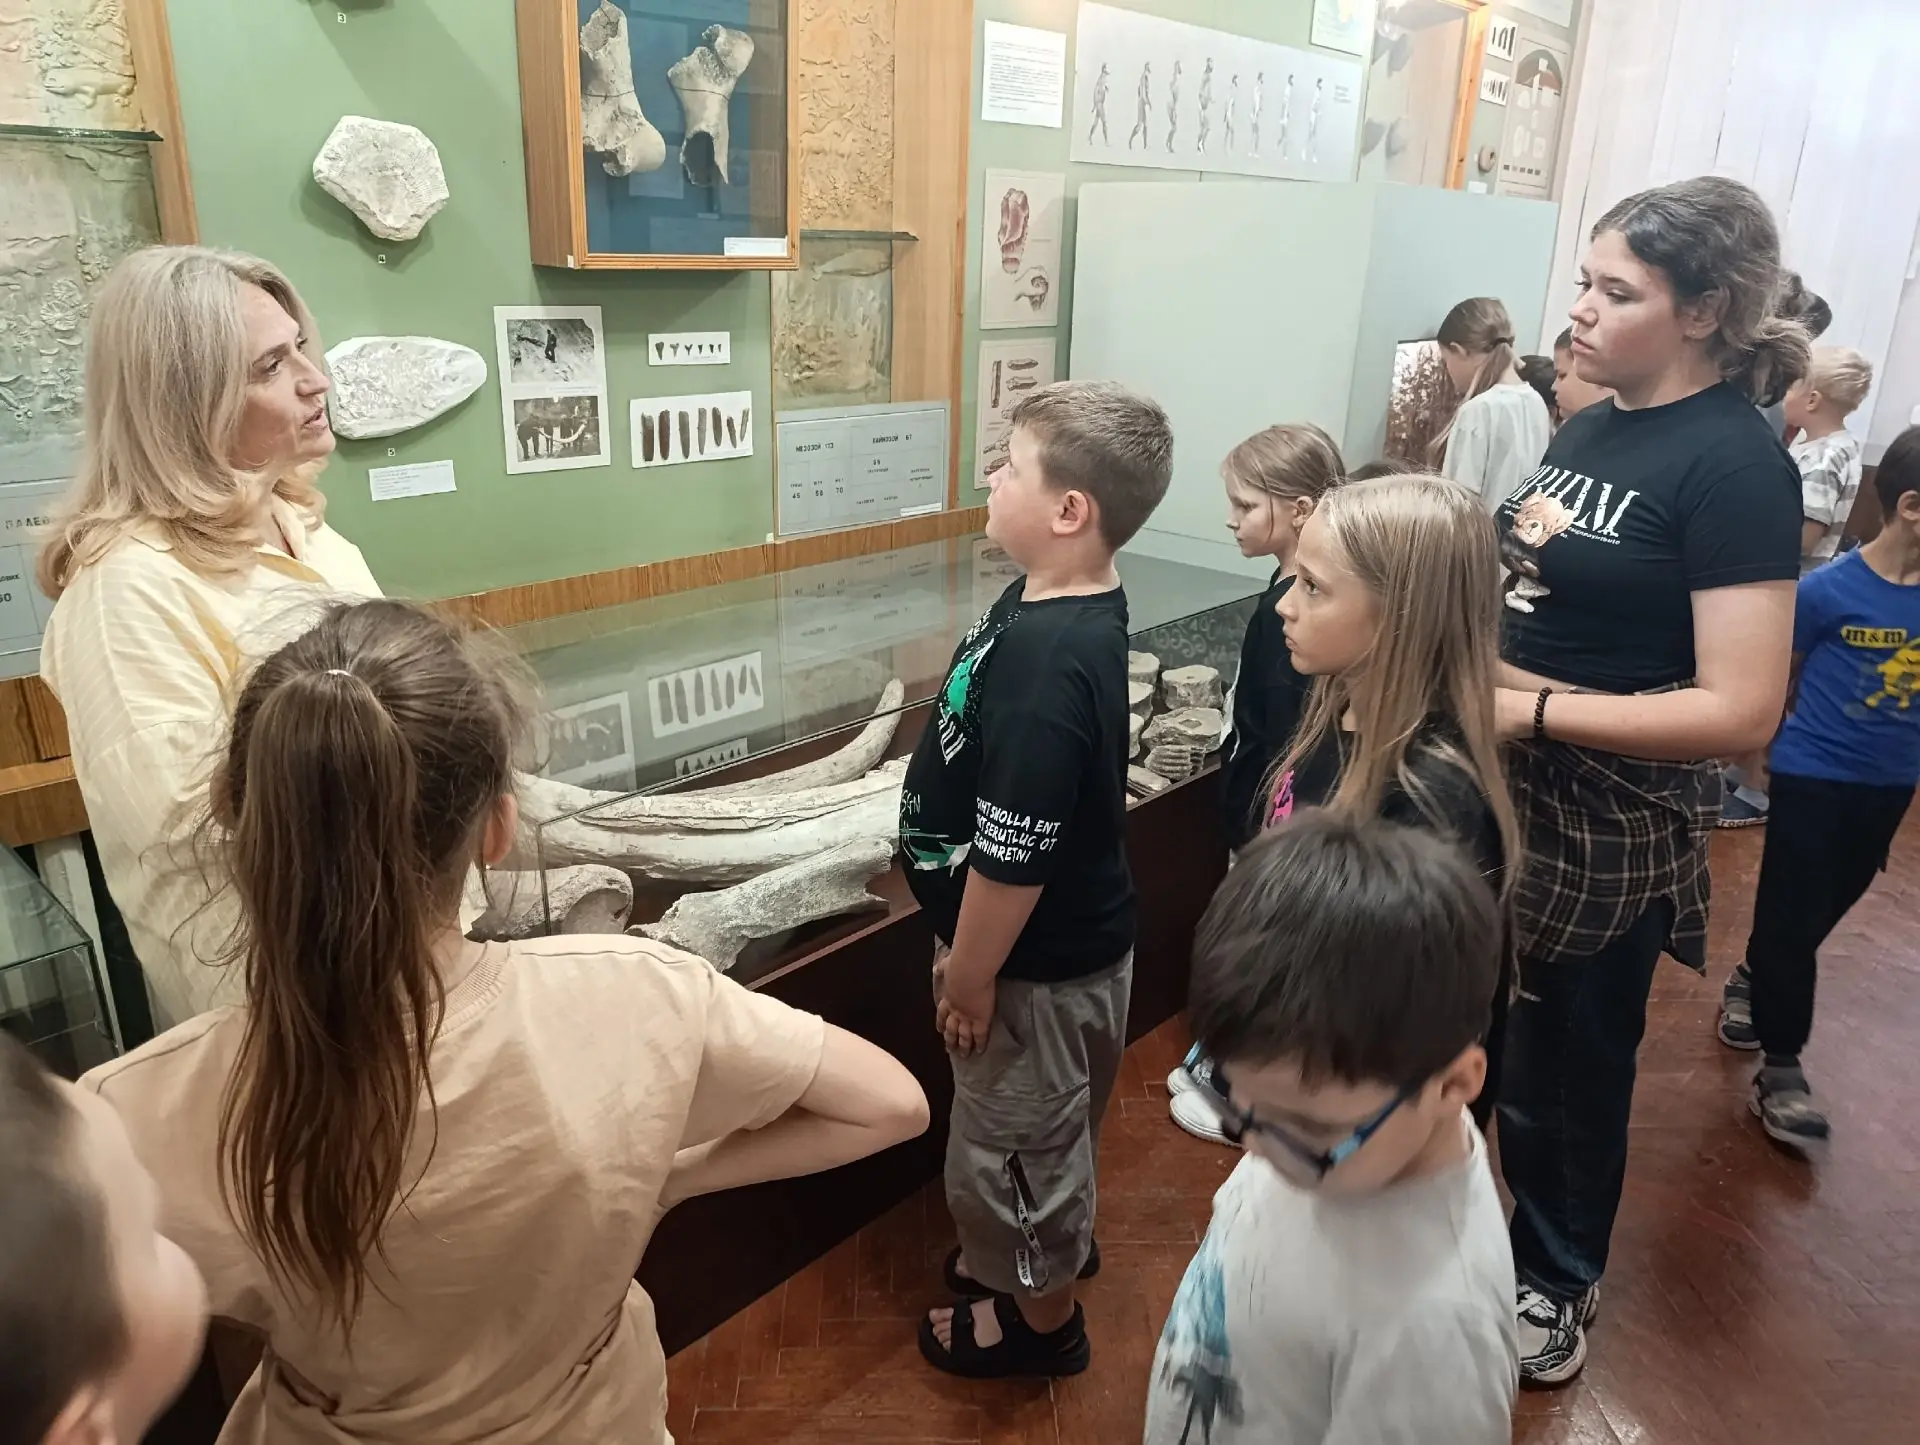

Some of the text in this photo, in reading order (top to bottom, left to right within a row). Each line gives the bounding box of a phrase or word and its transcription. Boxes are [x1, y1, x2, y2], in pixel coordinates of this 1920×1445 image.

[835, 486, 844, 494] 70
[5, 516, 51, 530] ПАЛЕО
[1039, 838, 1058, 852] OT
